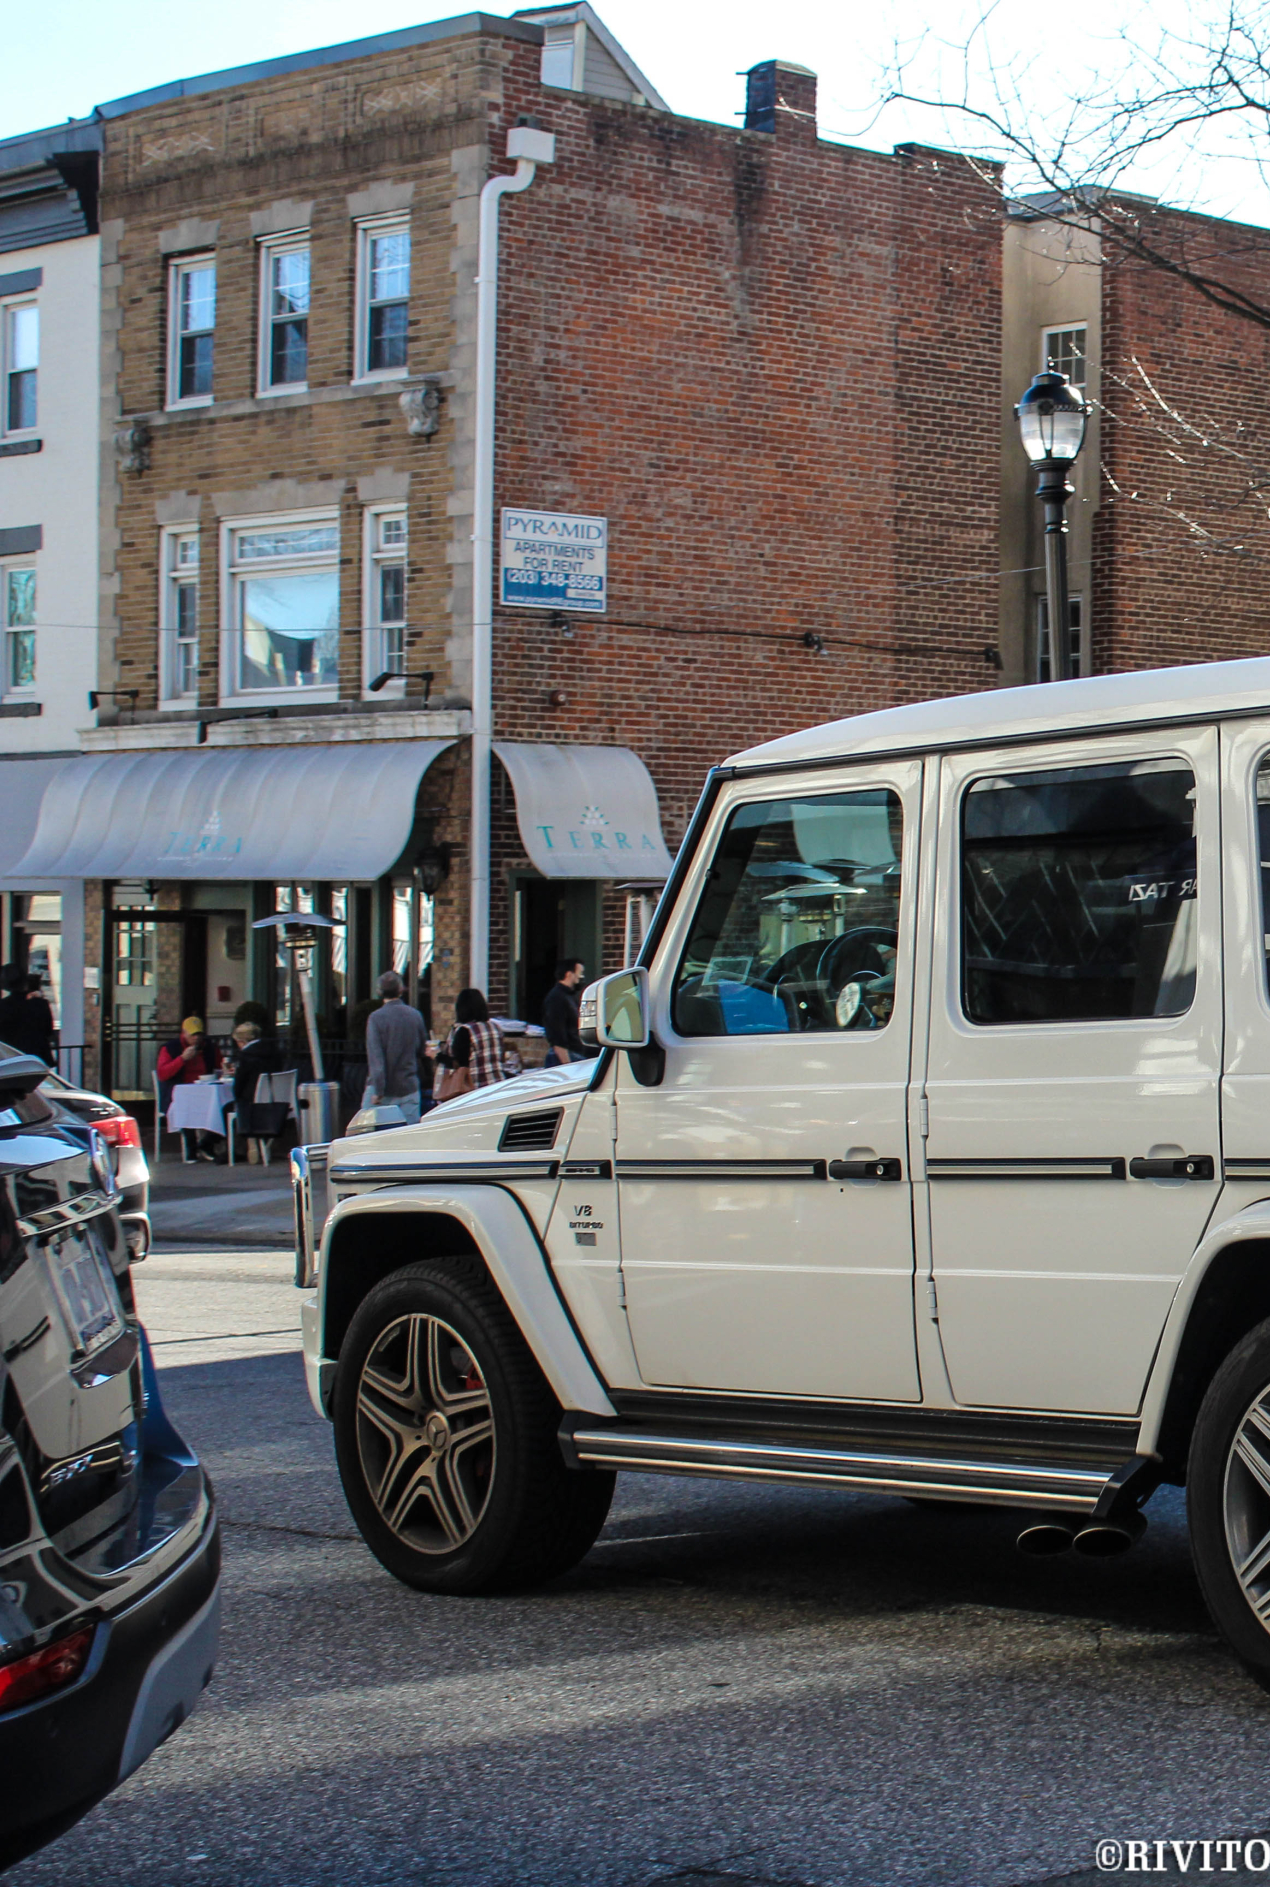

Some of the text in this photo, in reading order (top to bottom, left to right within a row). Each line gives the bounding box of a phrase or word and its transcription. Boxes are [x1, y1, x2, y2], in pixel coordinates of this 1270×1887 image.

[507, 516, 603, 540] PYRAMID
[514, 541, 595, 560] APARTMENTS
[523, 556, 583, 573] FOR RENT
[507, 568, 601, 590] (203) 348-8566
[536, 825, 656, 850] TERRA
[574, 1204, 593, 1217] V8
